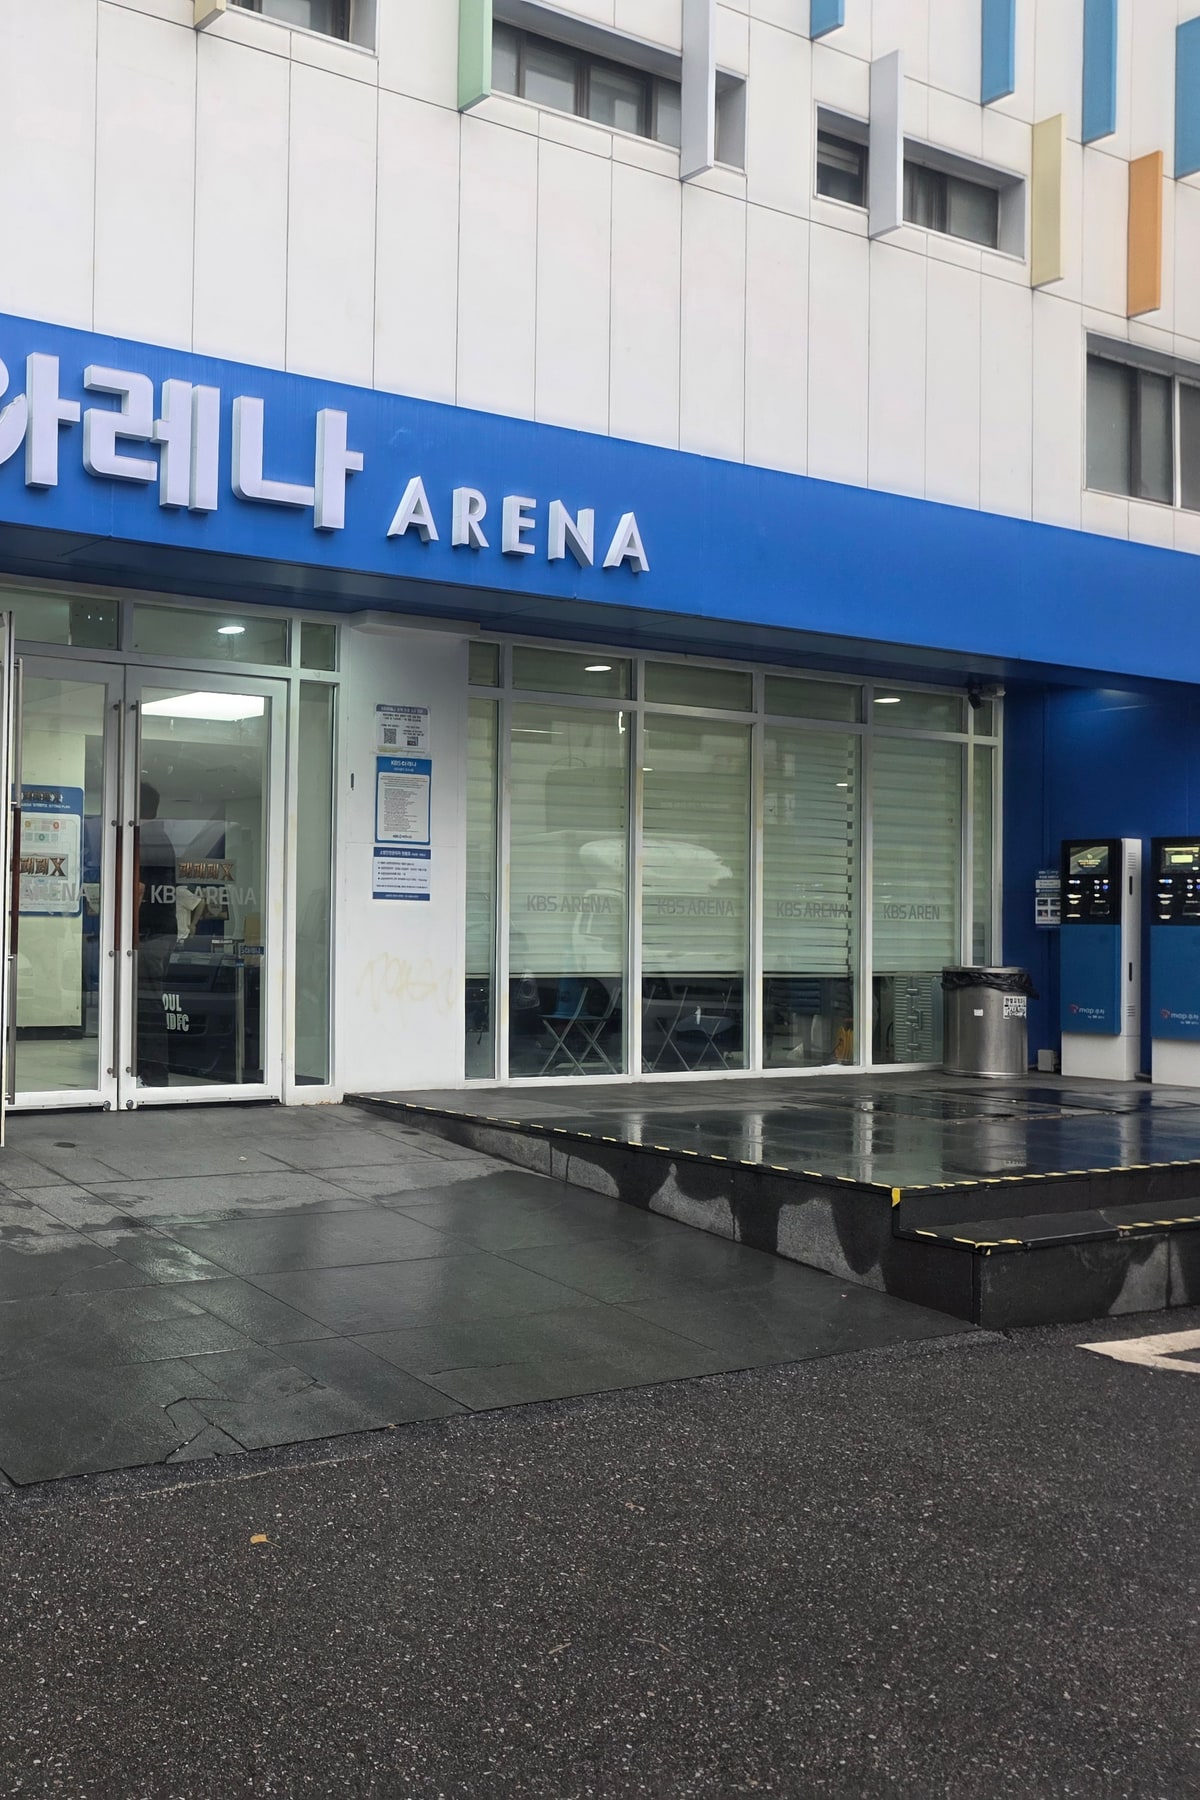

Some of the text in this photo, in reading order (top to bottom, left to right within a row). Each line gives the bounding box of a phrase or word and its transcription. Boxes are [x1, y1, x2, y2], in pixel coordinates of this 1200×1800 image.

[386, 475, 650, 573] ARENA
[526, 895, 612, 913] KBS ARENA
[658, 898, 735, 916] KBS ARENA
[776, 902, 802, 918] KBS
[883, 904, 907, 919] KBS
